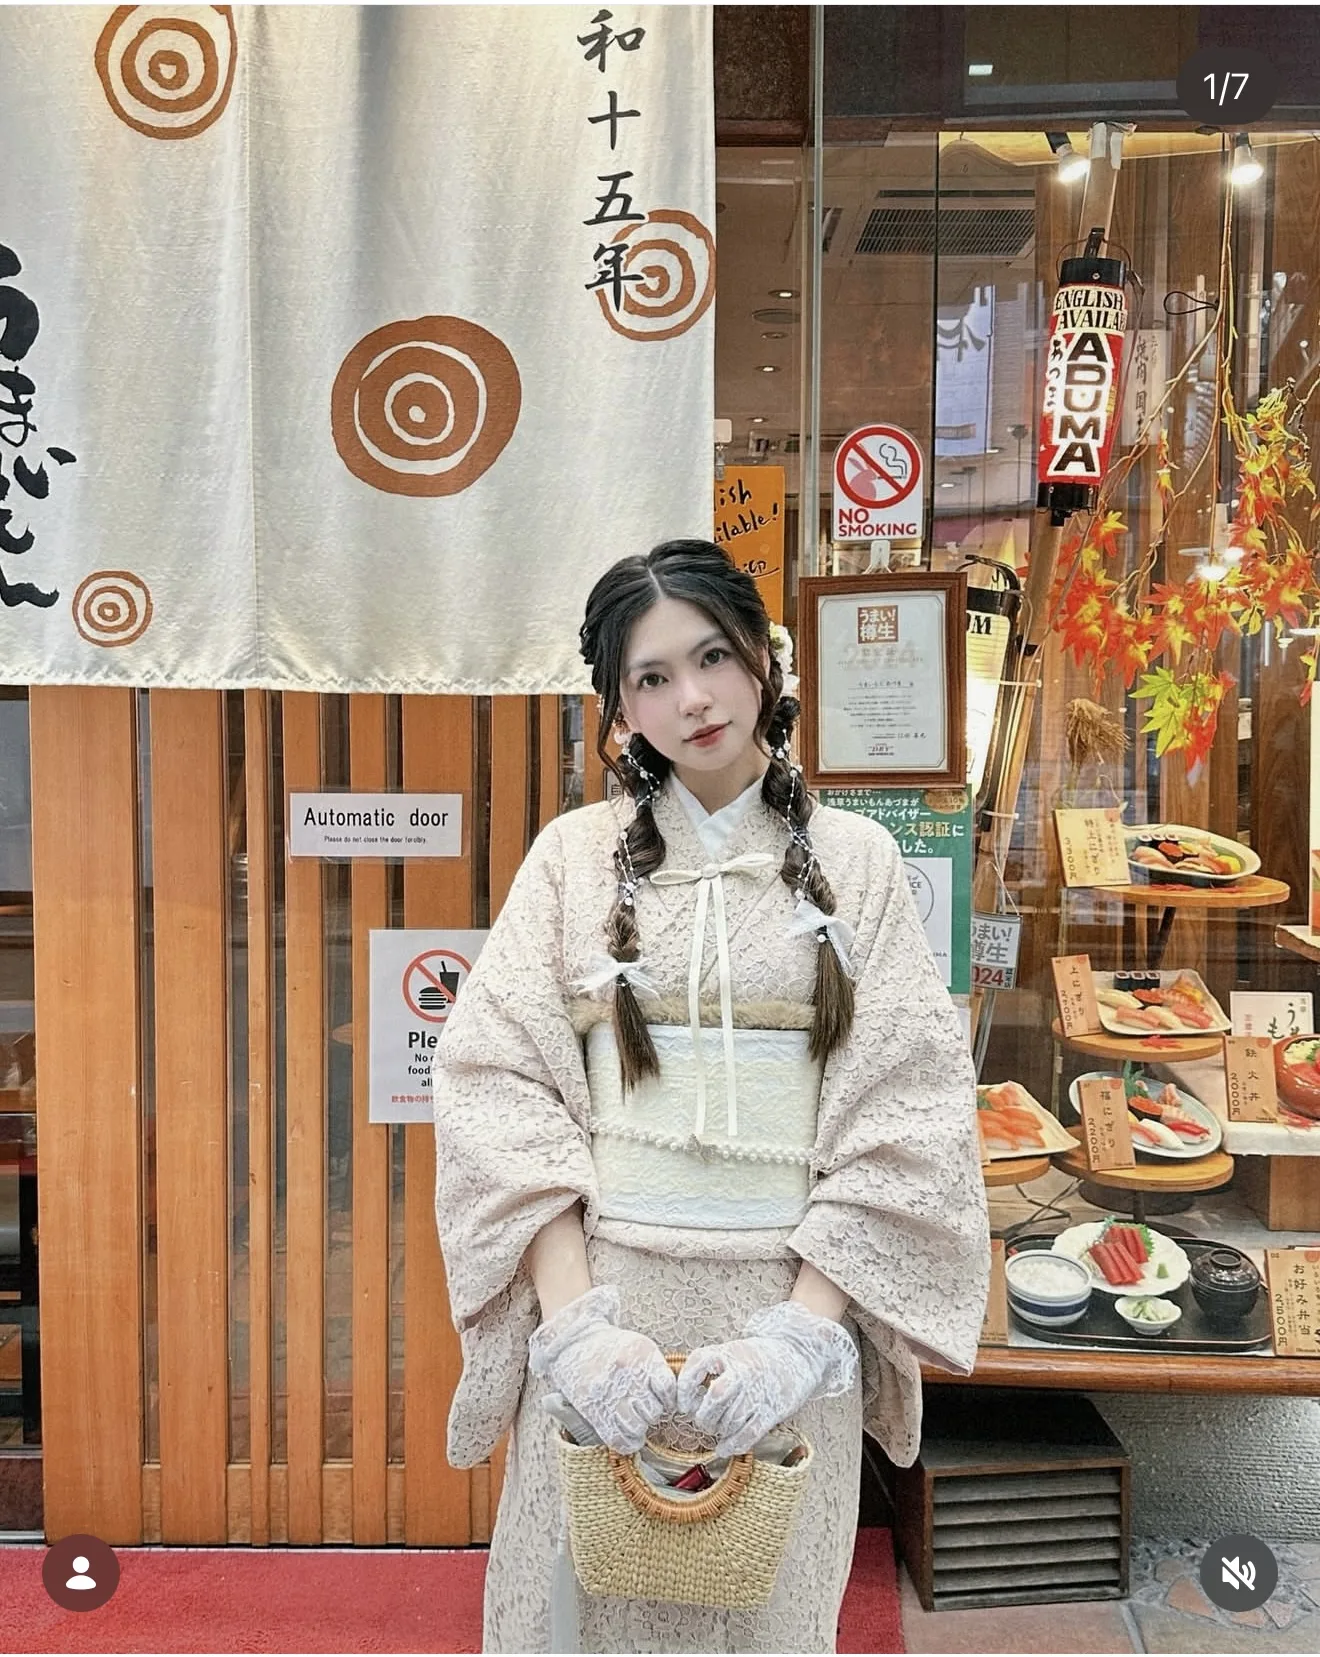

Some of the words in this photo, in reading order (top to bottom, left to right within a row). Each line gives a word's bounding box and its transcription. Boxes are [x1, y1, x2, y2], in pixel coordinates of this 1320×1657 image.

[577, 9, 646, 312] 和十五年
[1055, 289, 1124, 312] ENGLISH
[1054, 332, 1108, 473] ADUMA
[714, 478, 752, 512] ish
[714, 502, 779, 544] ilable!
[839, 508, 869, 524] NO
[839, 523, 917, 537] SMOKING
[304, 807, 395, 827] Automatic
[409, 807, 449, 827] door
[324, 835, 342, 843] Please
[344, 835, 350, 843] do
[352, 835, 362, 843] not
[363, 835, 378, 843] close
[380, 835, 389, 843] the
[390, 835, 402, 843] door
[898, 838, 934, 854] した。
[408, 1030, 438, 1049] Ple
[415, 1053, 428, 1062] No
[408, 1065, 430, 1074] food
[1293, 1263, 1311, 1336] お好み弁当
[1275, 1293, 1288, 1347] 2,500円
